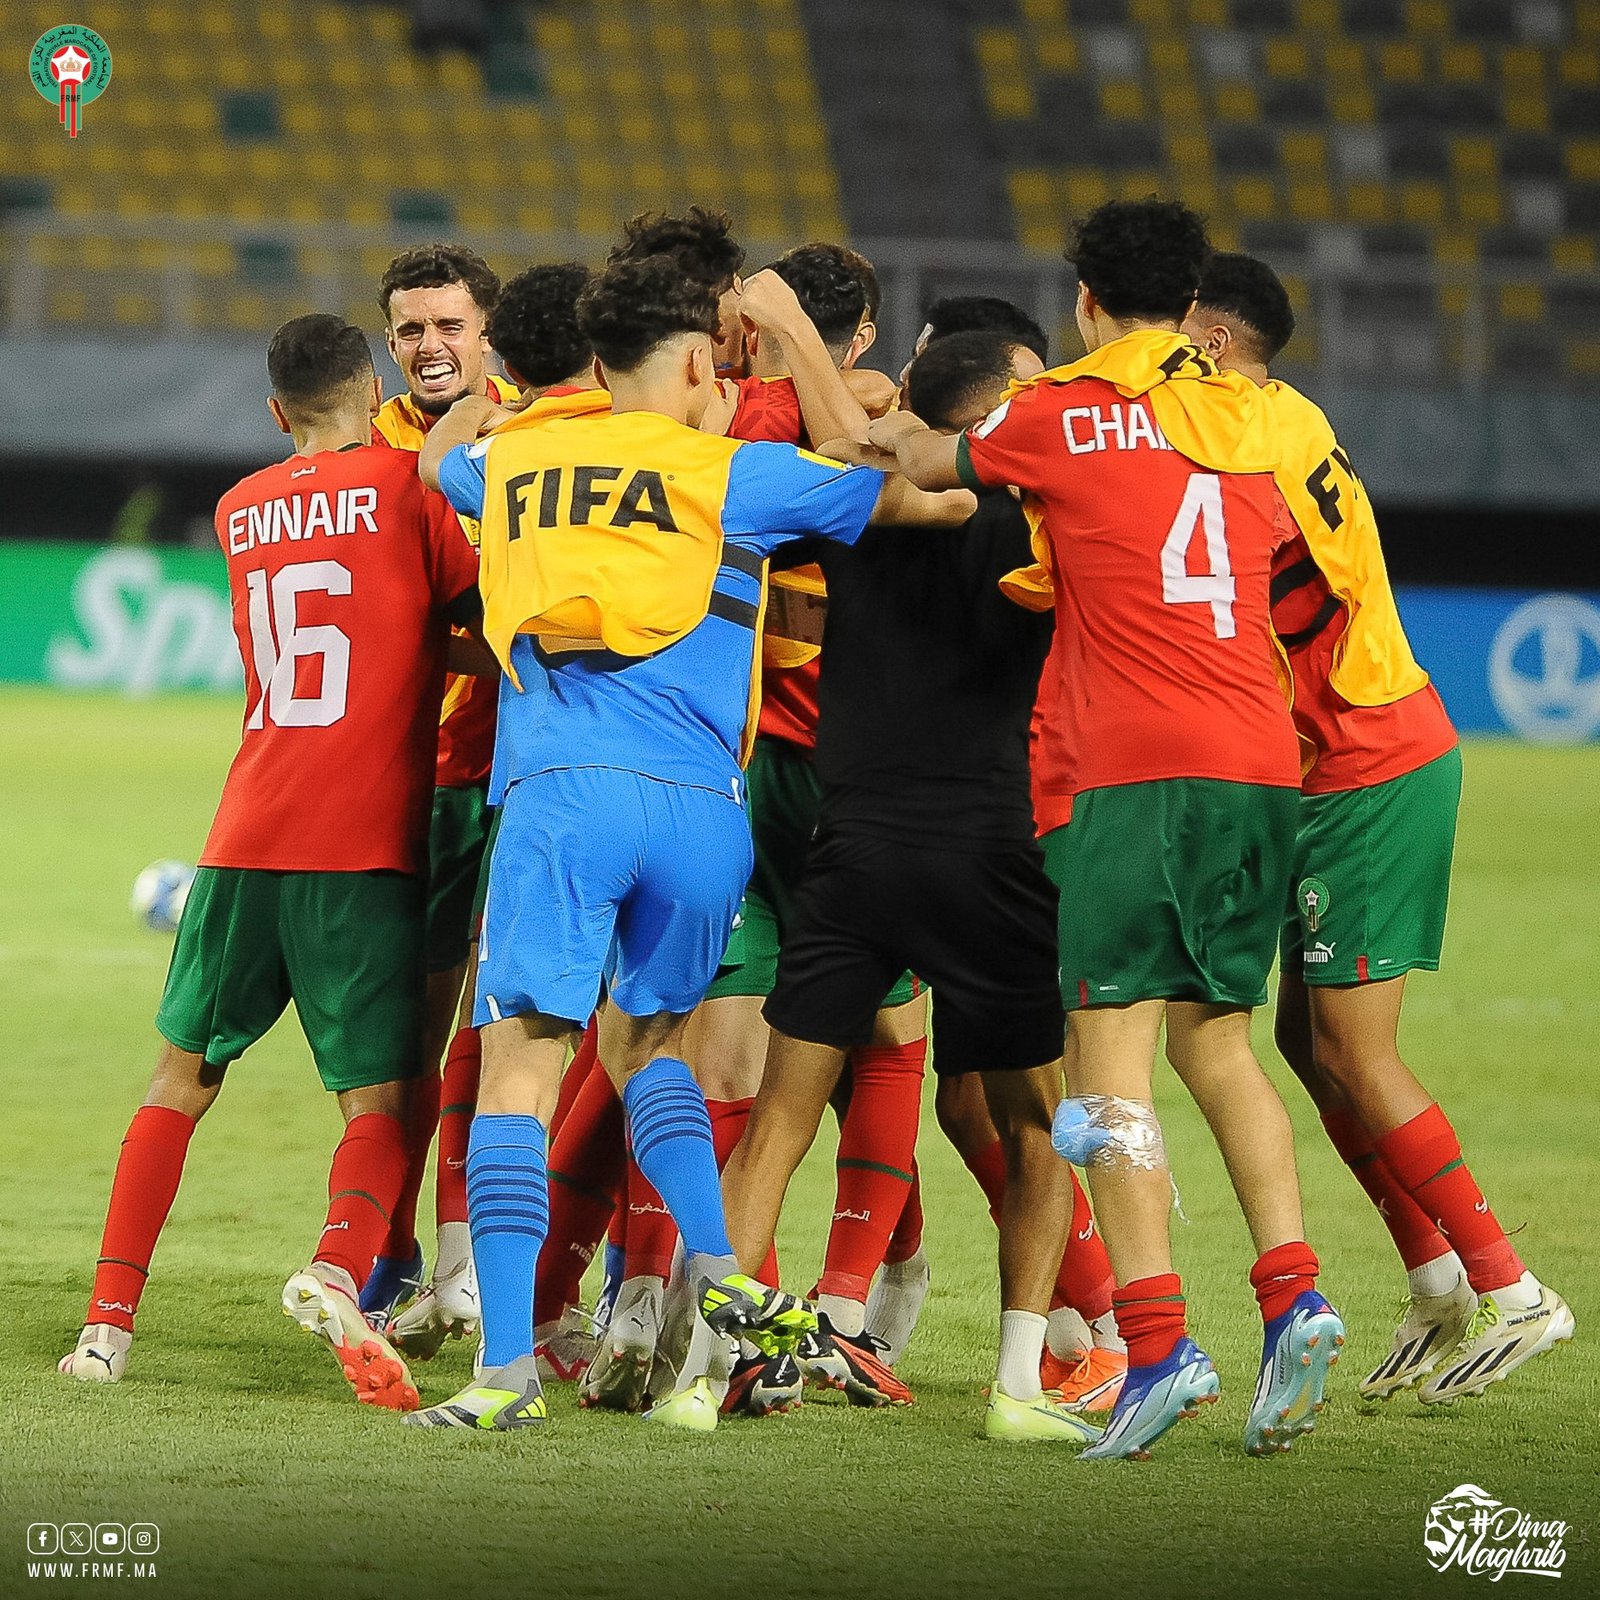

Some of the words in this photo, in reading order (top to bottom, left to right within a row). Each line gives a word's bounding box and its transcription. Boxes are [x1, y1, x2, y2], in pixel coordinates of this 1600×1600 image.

[228, 486, 379, 556] ENNAIR
[505, 466, 680, 542] FIFA
[1161, 473, 1236, 639] 4
[246, 560, 352, 730] 16
